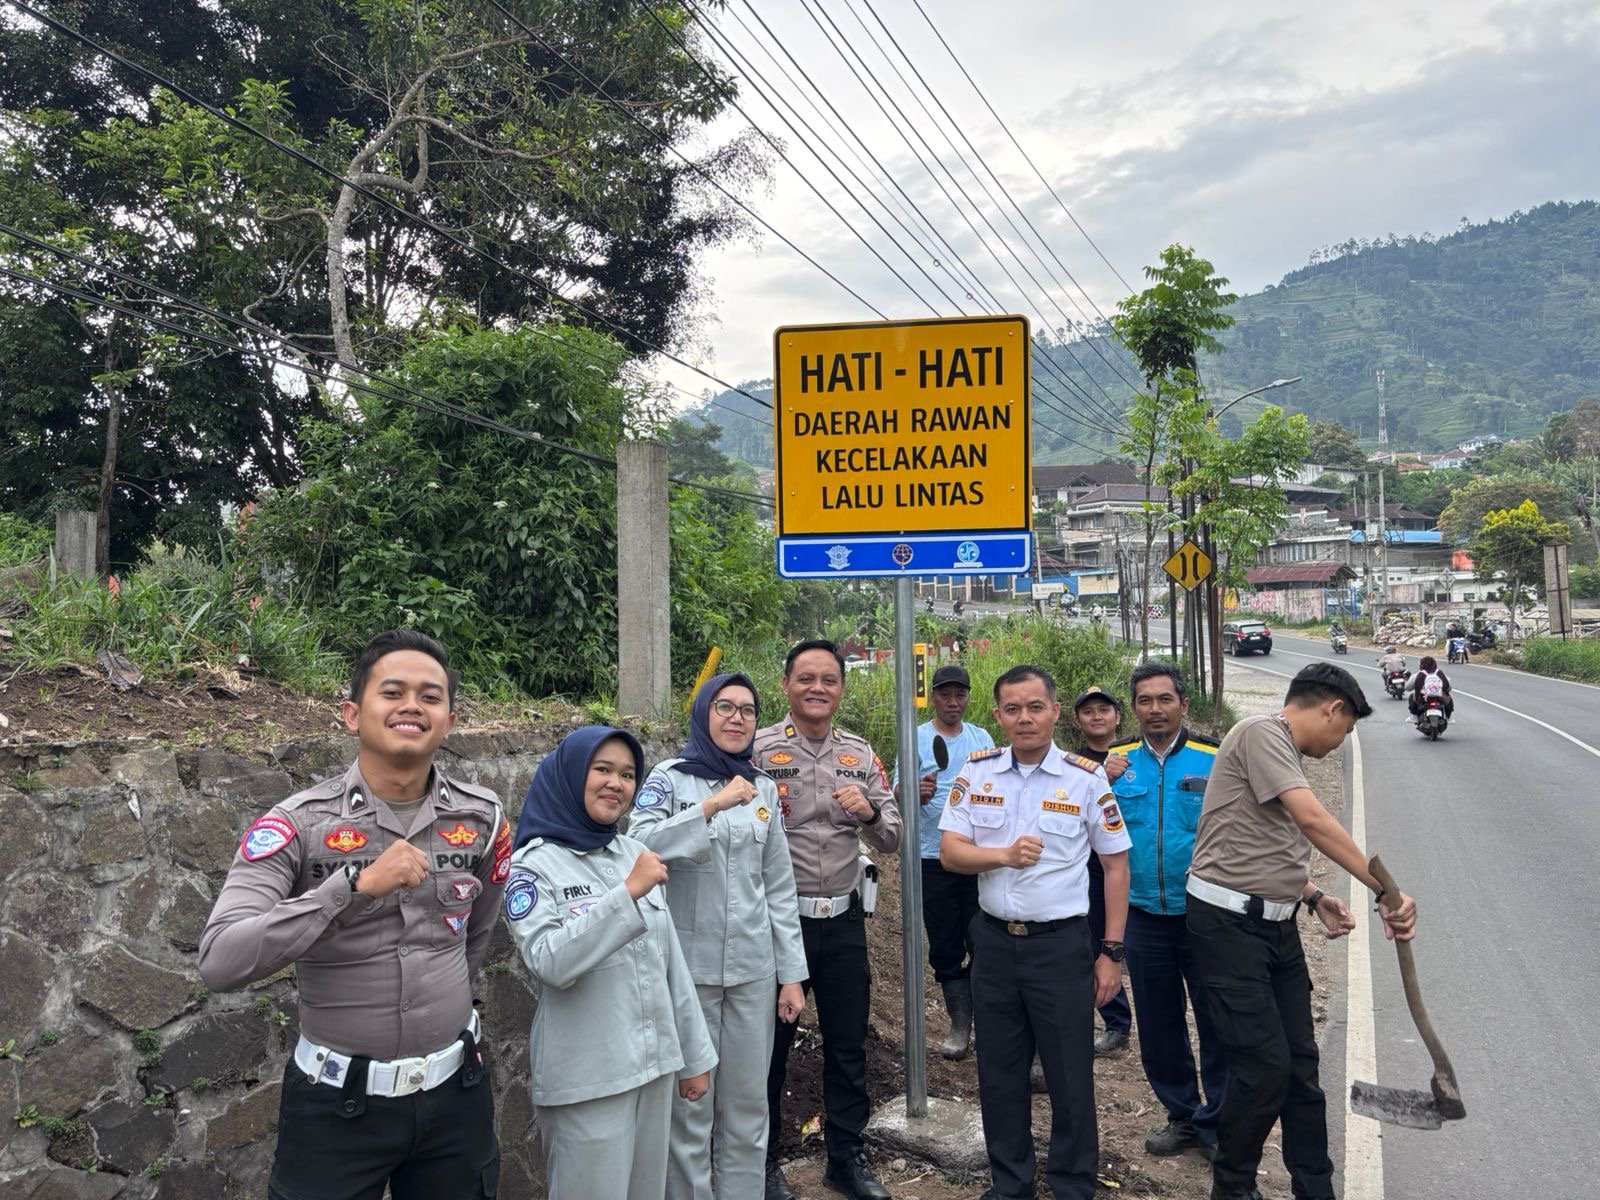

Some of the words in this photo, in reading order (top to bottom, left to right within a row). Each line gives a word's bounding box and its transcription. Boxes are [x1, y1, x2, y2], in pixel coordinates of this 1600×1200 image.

[801, 352, 882, 393] HATI
[919, 347, 1003, 389] HATI
[795, 410, 898, 437] DAERAH
[911, 405, 1010, 433] RAWAN
[817, 444, 987, 473] KECELAKAAN
[822, 484, 884, 509] LALU
[896, 481, 984, 507] LINTAS
[836, 769, 867, 780] POLRI
[972, 795, 1002, 804] DIDIN
[563, 885, 592, 900] FIRLY
